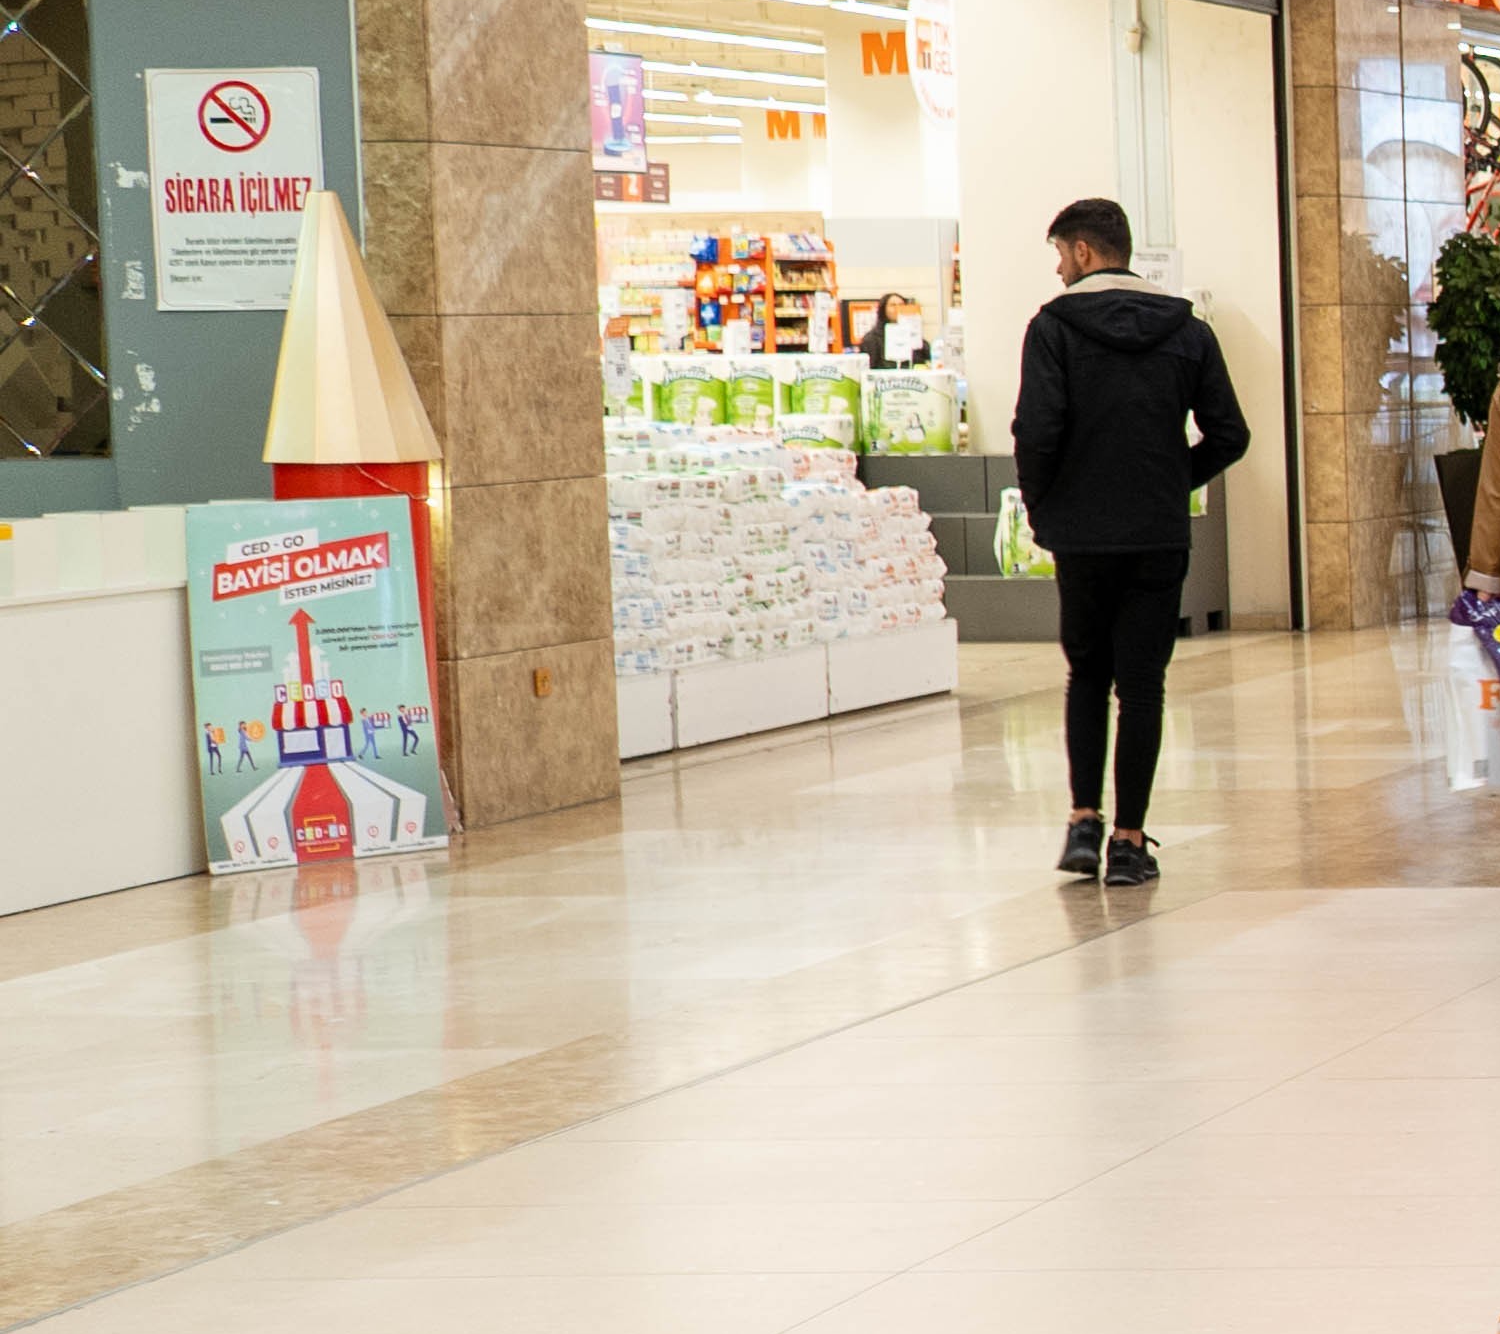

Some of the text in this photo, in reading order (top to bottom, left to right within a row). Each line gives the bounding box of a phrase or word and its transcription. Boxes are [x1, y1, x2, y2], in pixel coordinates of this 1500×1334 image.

[165, 173, 235, 213] SİGARA
[241, 541, 271, 557] CED
[283, 535, 305, 549] GO
[216, 542, 385, 595] BAYİSİ OLMAK
